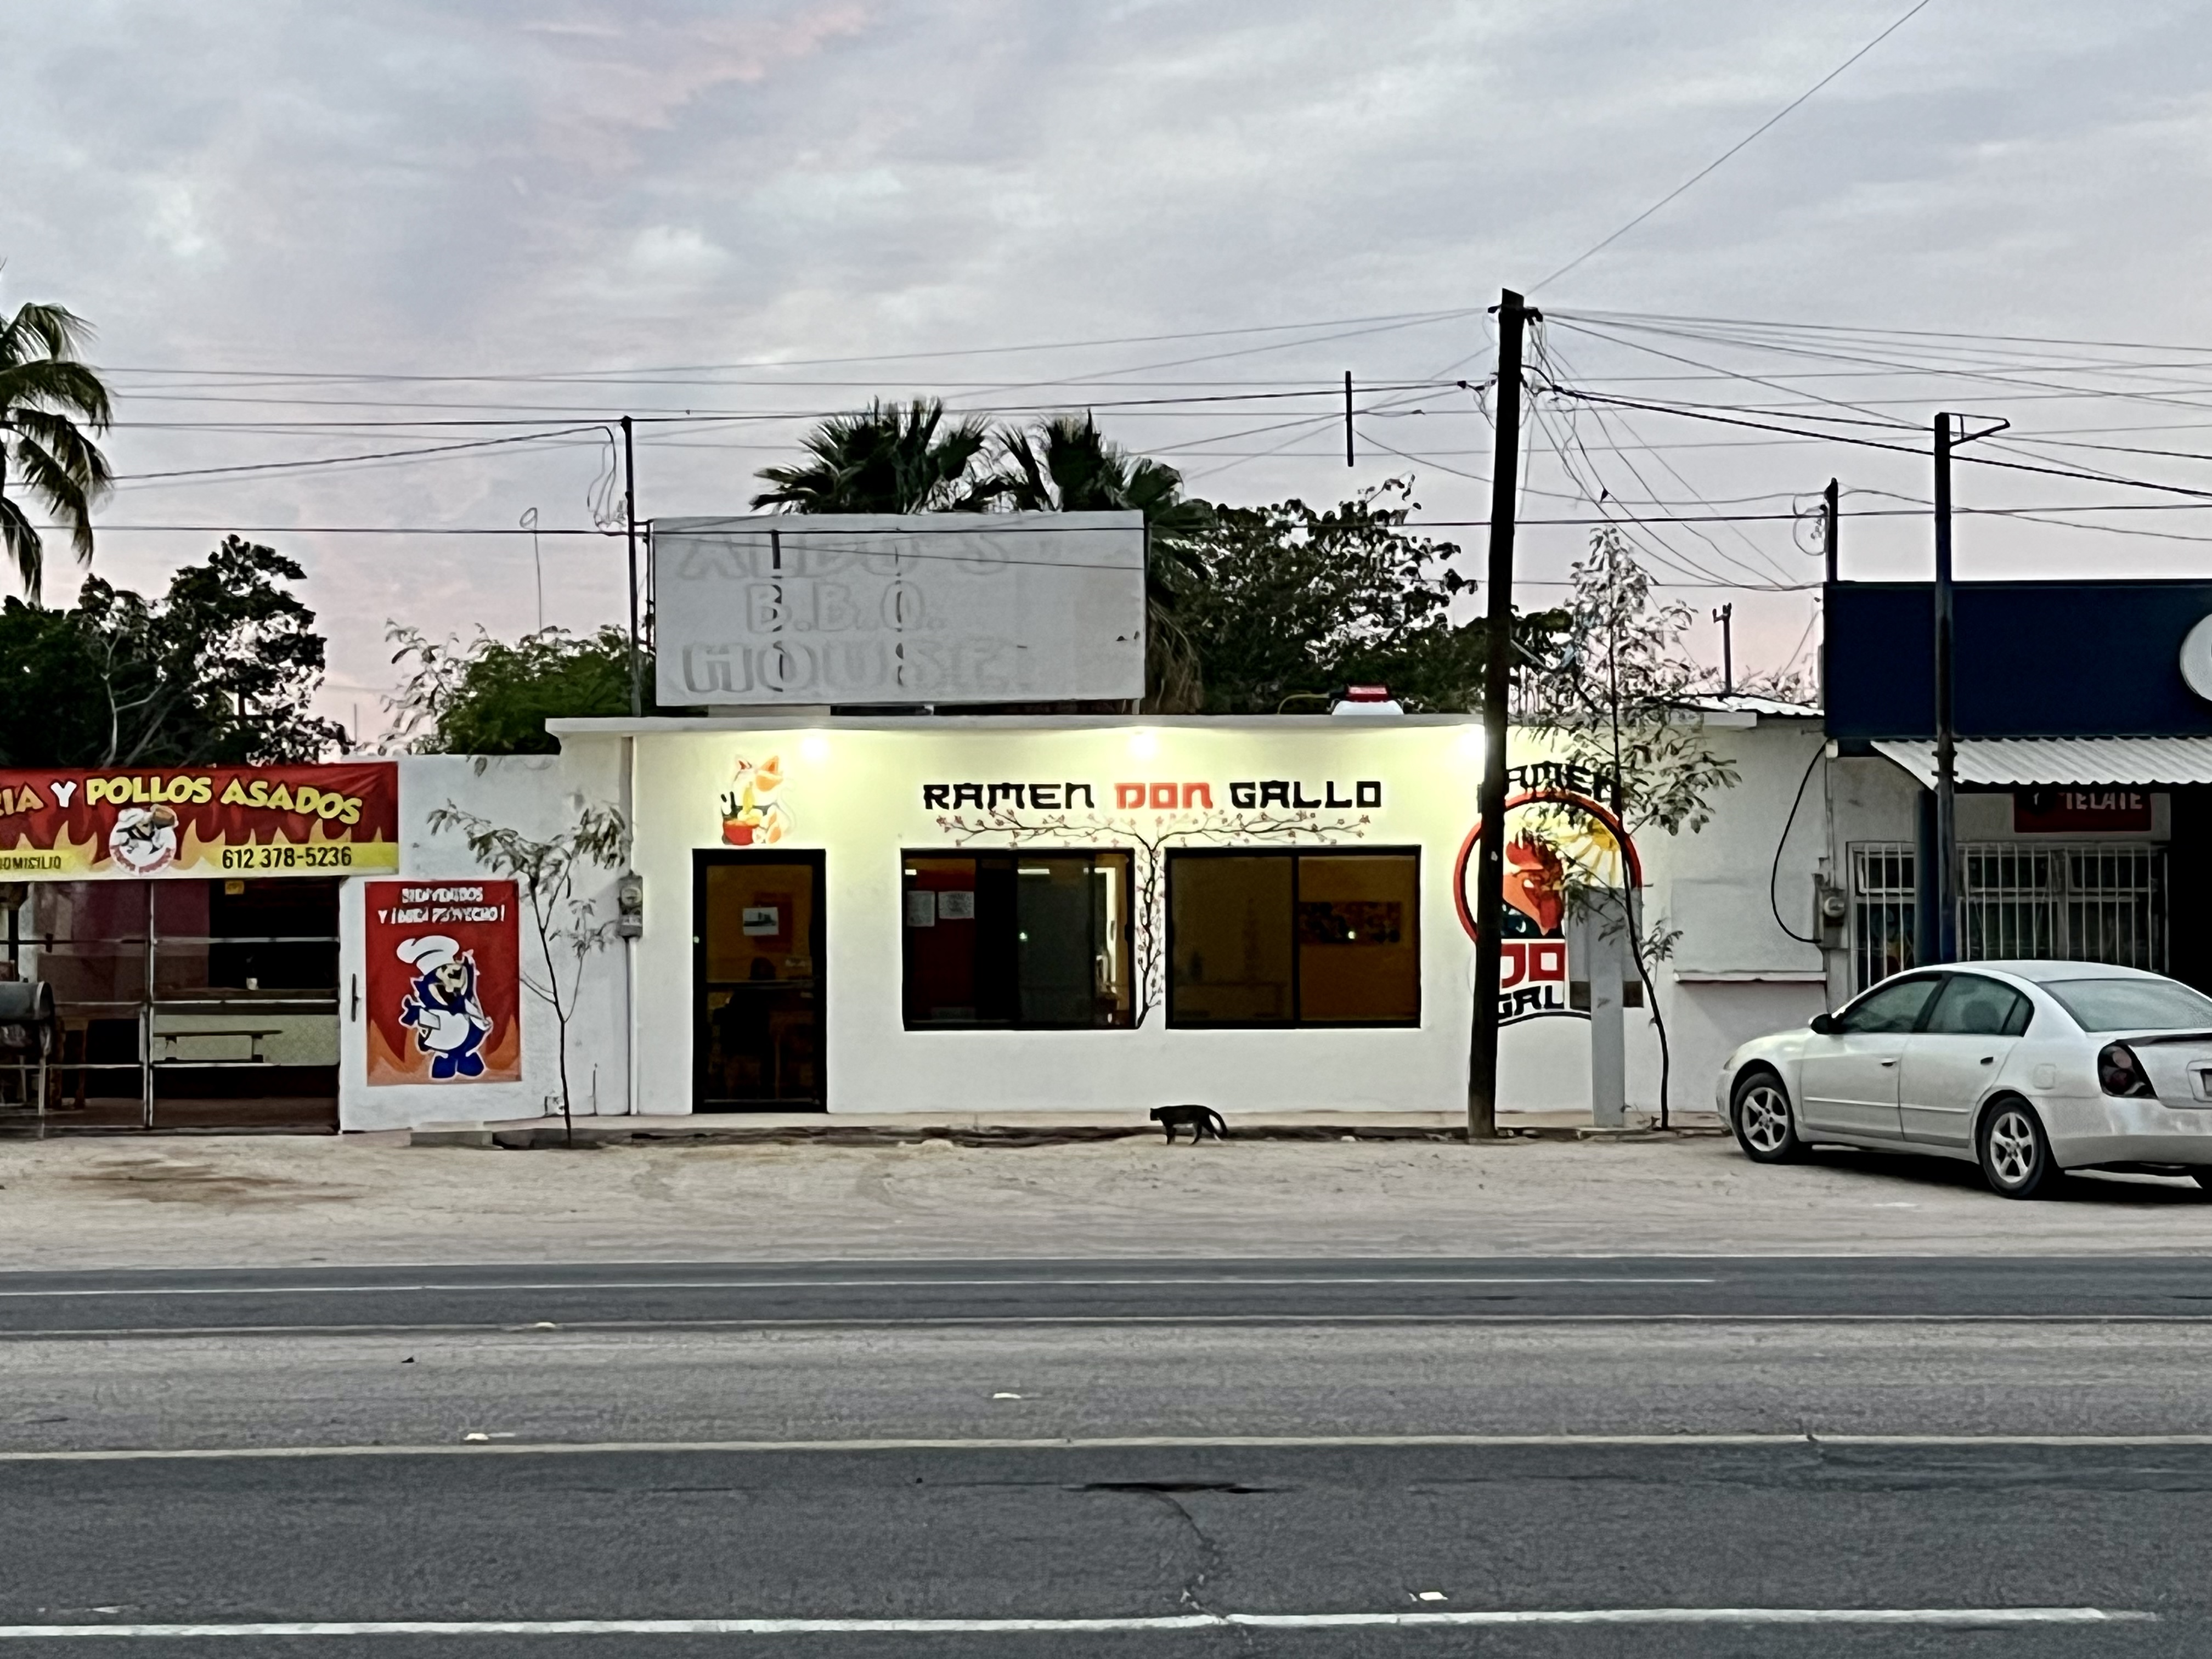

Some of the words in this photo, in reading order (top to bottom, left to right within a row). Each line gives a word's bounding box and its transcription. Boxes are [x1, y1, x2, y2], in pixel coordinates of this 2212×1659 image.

[0, 785, 44, 816] IA
[50, 781, 77, 808] Y
[86, 775, 212, 806] POLLOS
[220, 777, 363, 825] ASADOS
[923, 782, 1094, 810] RAMEN
[1114, 782, 1214, 810] DON
[1229, 780, 1381, 809] GALLO
[1504, 760, 1617, 805] AMEN
[222, 849, 254, 869] 612
[259, 847, 352, 868] 378-5236
